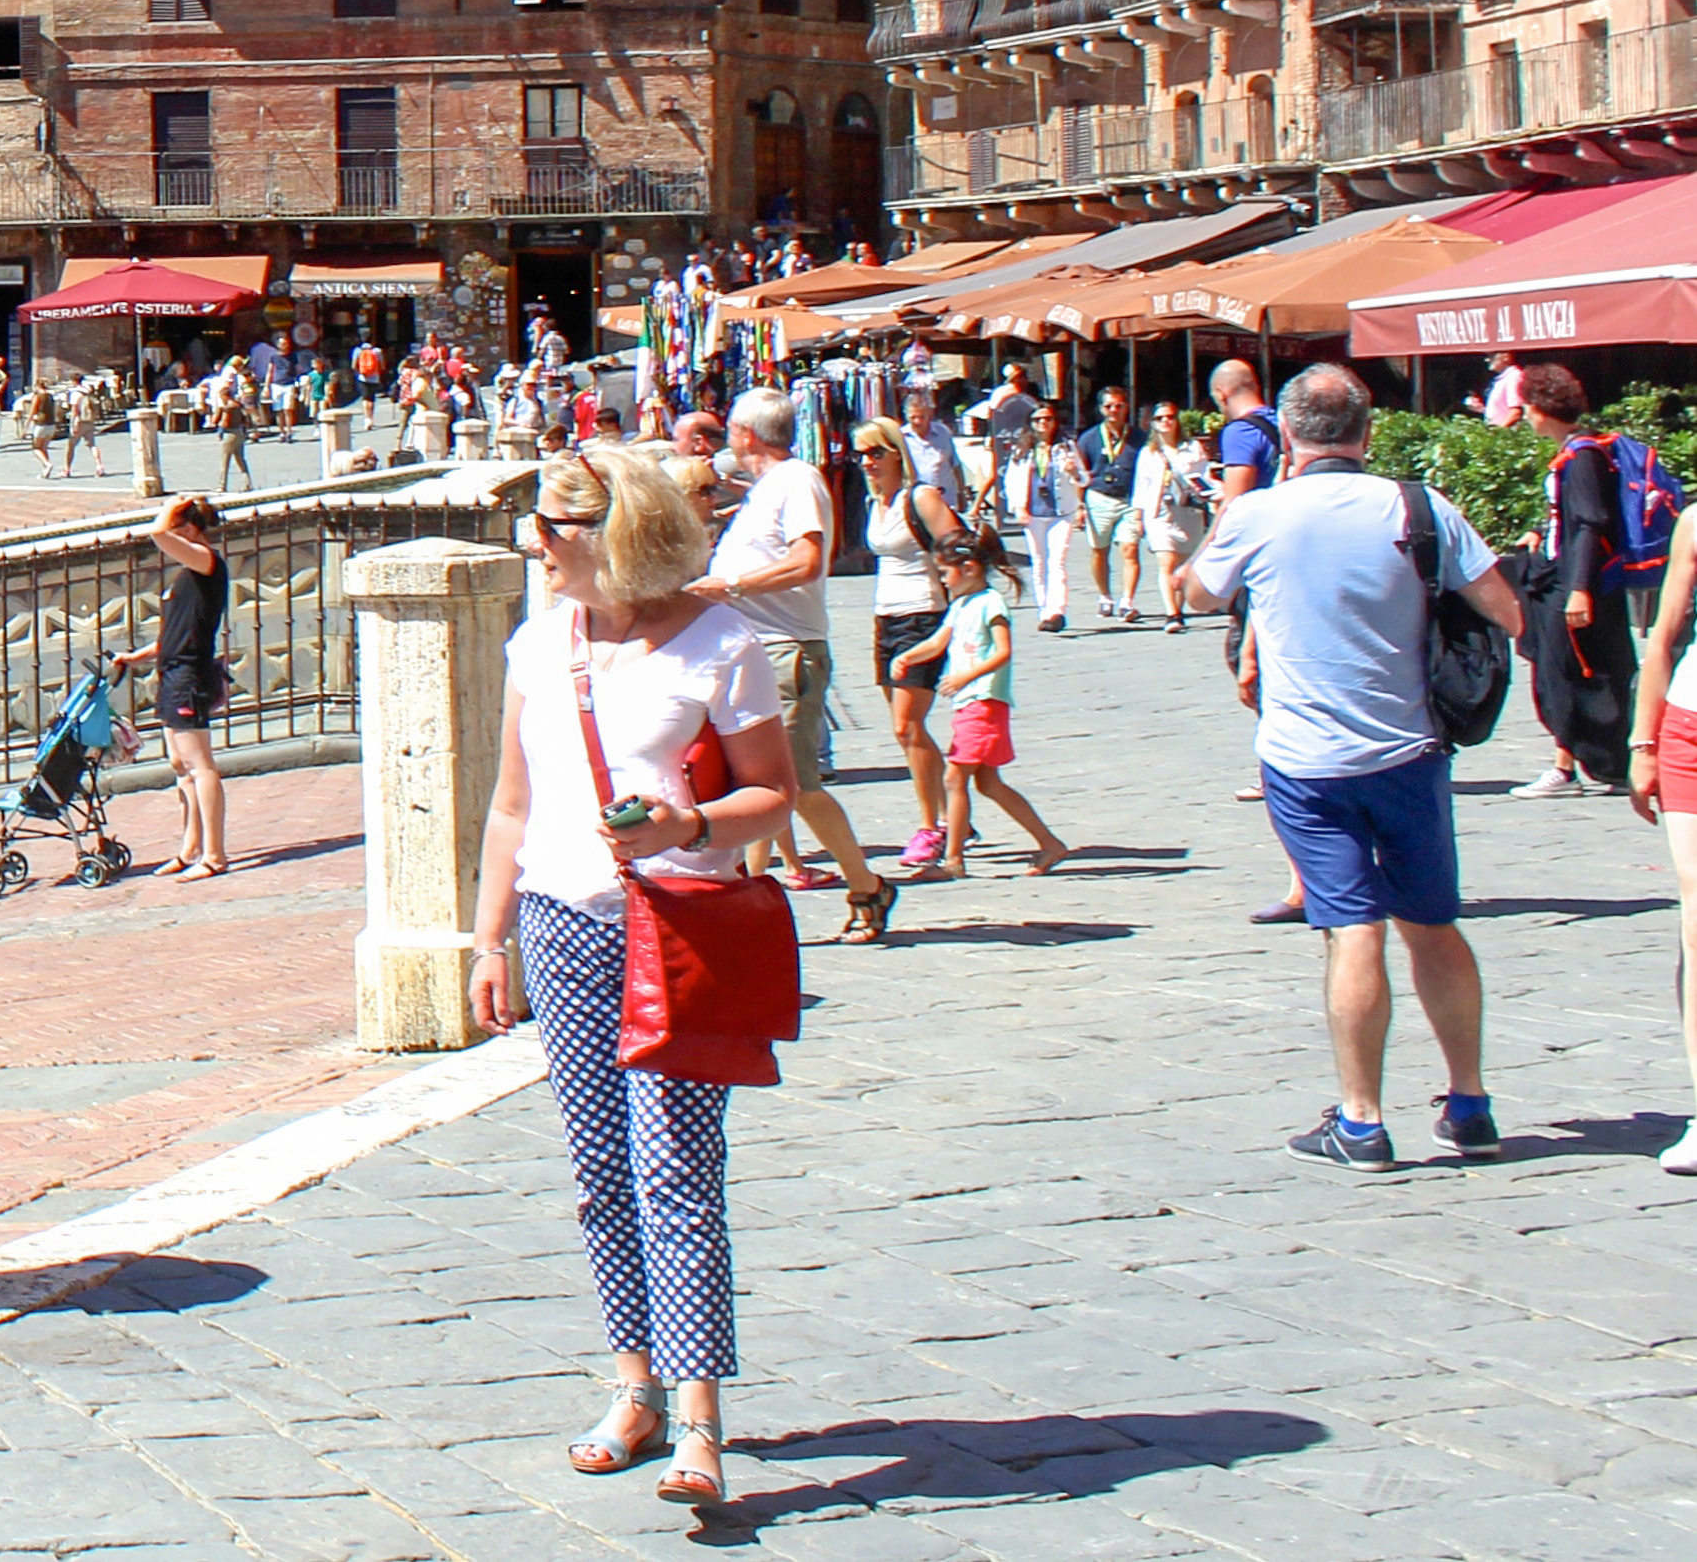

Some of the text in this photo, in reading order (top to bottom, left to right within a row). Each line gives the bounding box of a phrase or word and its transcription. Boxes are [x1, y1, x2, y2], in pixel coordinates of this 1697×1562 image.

[312, 283, 418, 295] ANTICA SIENA
[30, 302, 195, 322] LIBERAMENTE OSTERIA
[1416, 300, 1576, 347] RISTORANTE AL MANGIA
